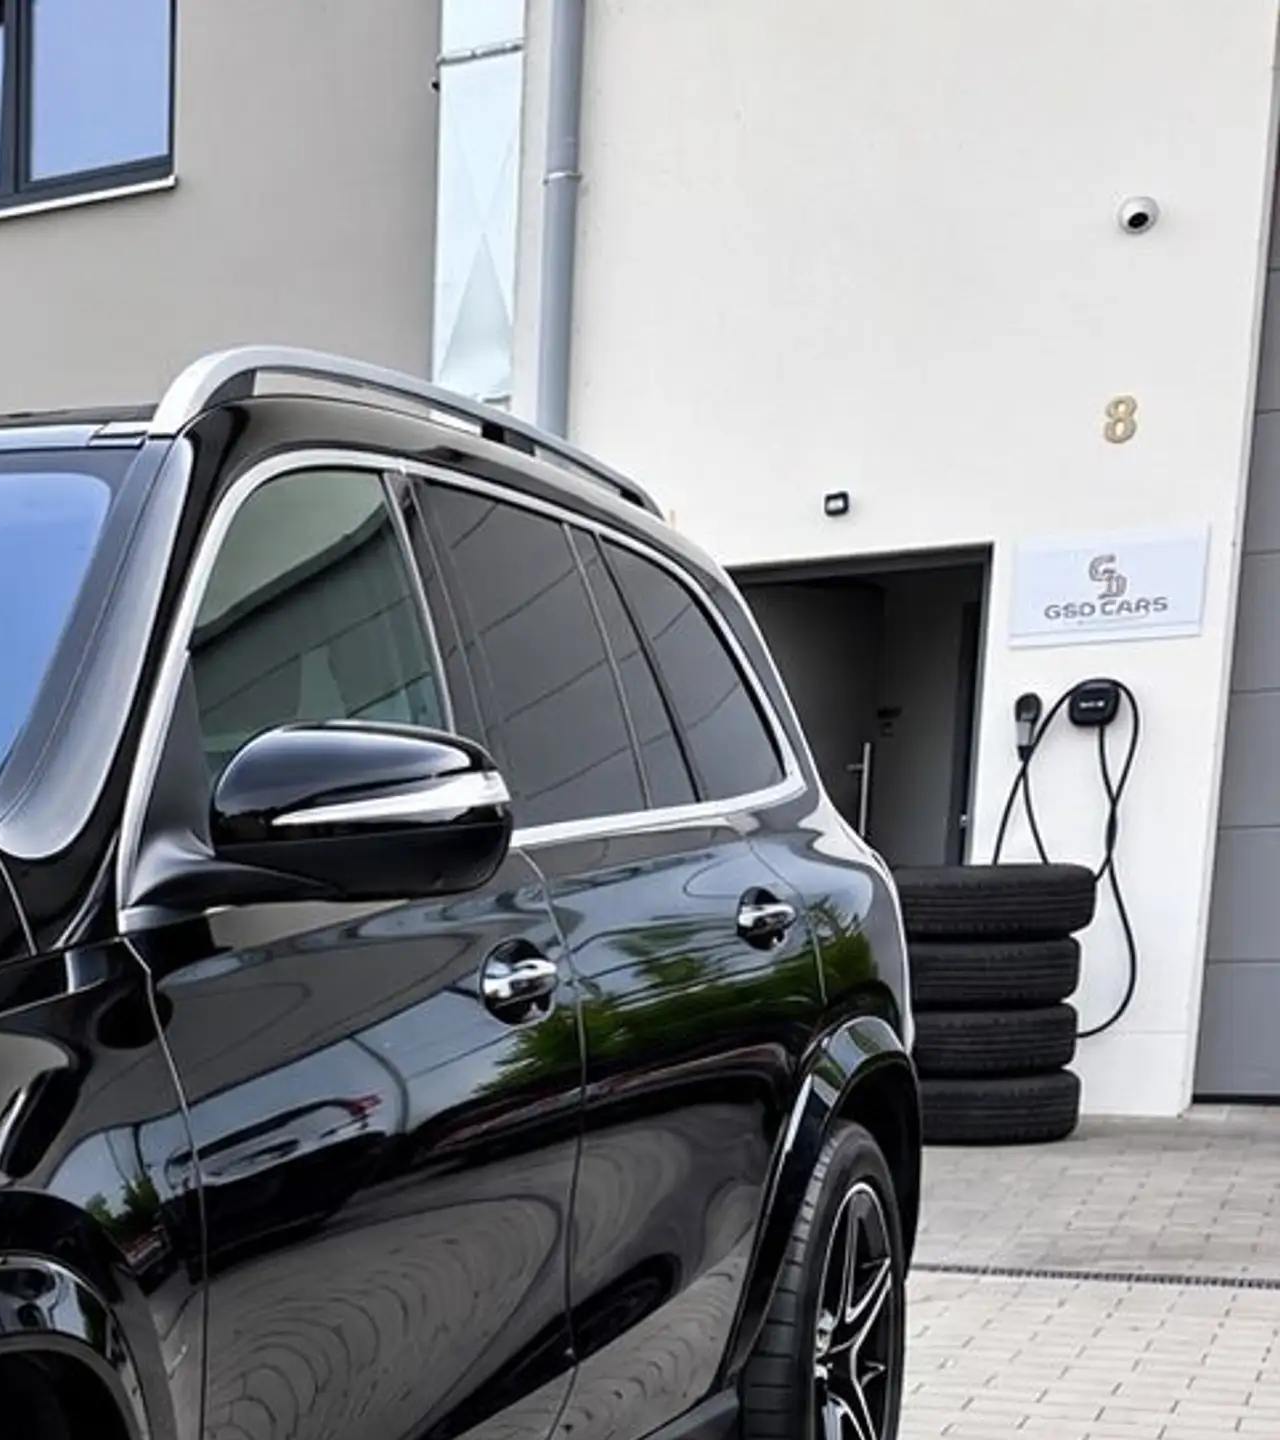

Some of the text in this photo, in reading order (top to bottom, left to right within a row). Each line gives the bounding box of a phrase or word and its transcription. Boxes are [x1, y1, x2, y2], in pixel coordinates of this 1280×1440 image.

[1104, 395, 1137, 444] 8
[1044, 597, 1168, 620] GSD CARS
